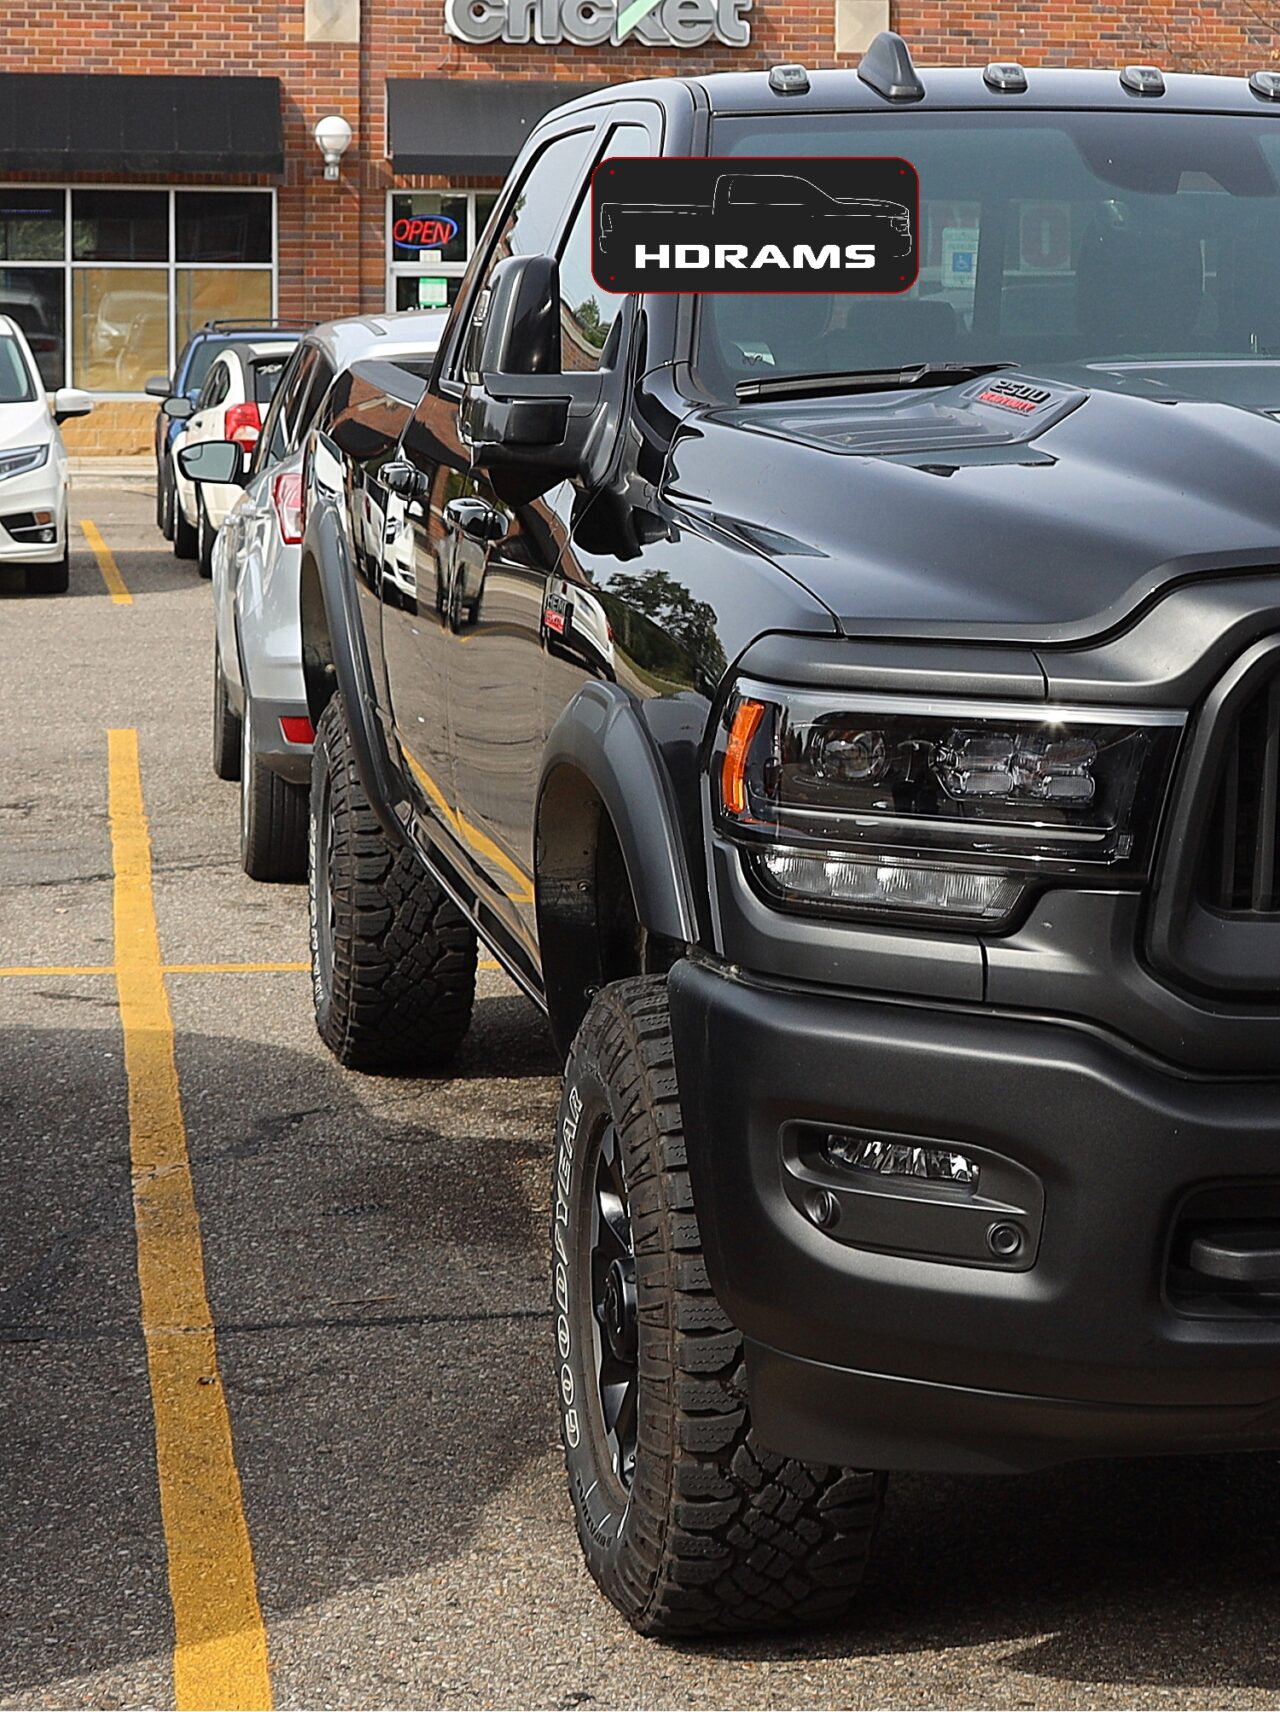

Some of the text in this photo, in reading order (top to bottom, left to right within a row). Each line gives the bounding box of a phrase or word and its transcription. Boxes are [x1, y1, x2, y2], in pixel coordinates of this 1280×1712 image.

[444, 0, 750, 47] cricket
[393, 218, 452, 244] OPEN
[989, 381, 1051, 404] 2500
[554, 1086, 583, 1448] GOODYEAR
